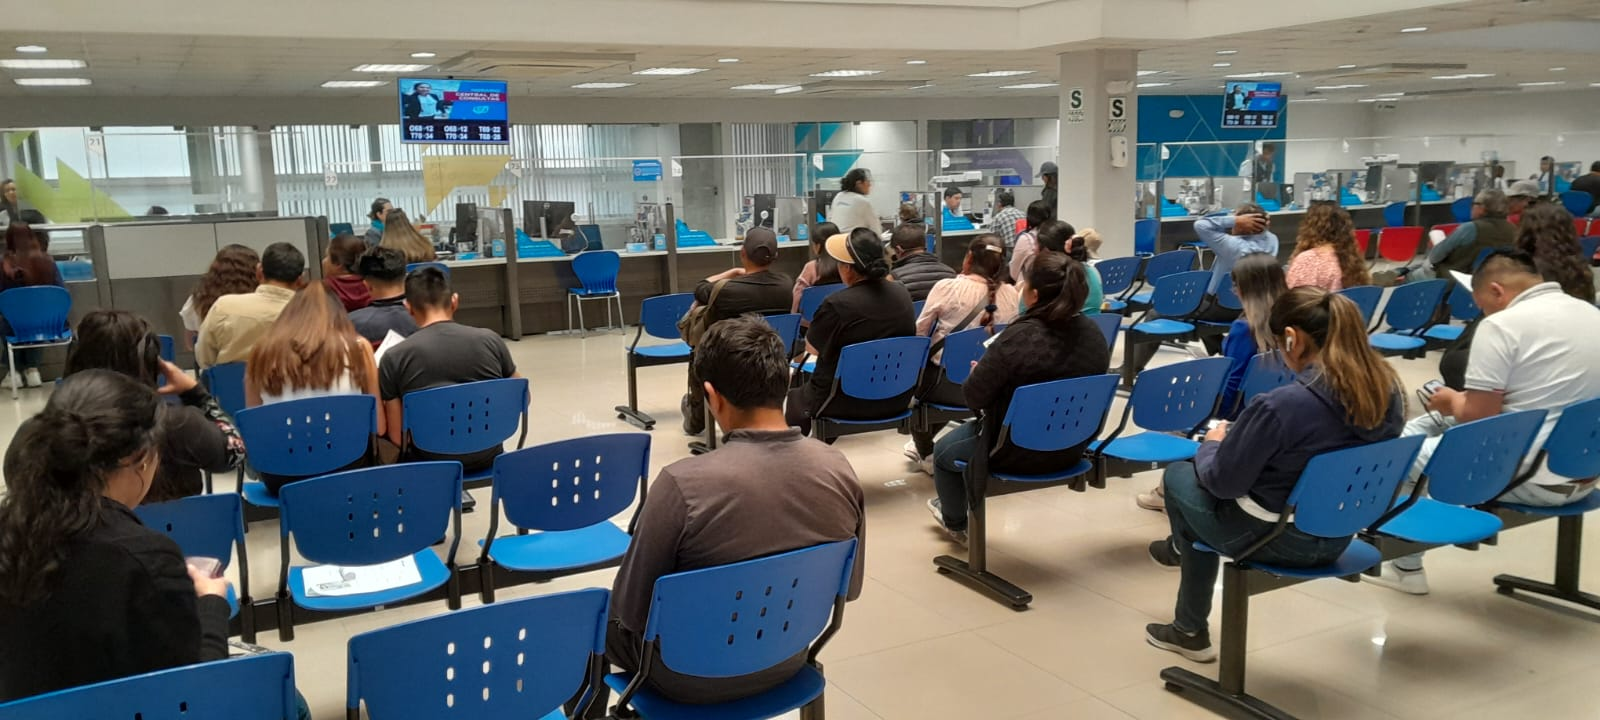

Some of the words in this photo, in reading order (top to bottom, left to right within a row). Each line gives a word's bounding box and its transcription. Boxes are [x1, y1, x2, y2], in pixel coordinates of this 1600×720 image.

[1071, 90, 1082, 109] S
[1112, 99, 1123, 118] S
[89, 138, 100, 146] 21
[326, 175, 337, 184] 22
